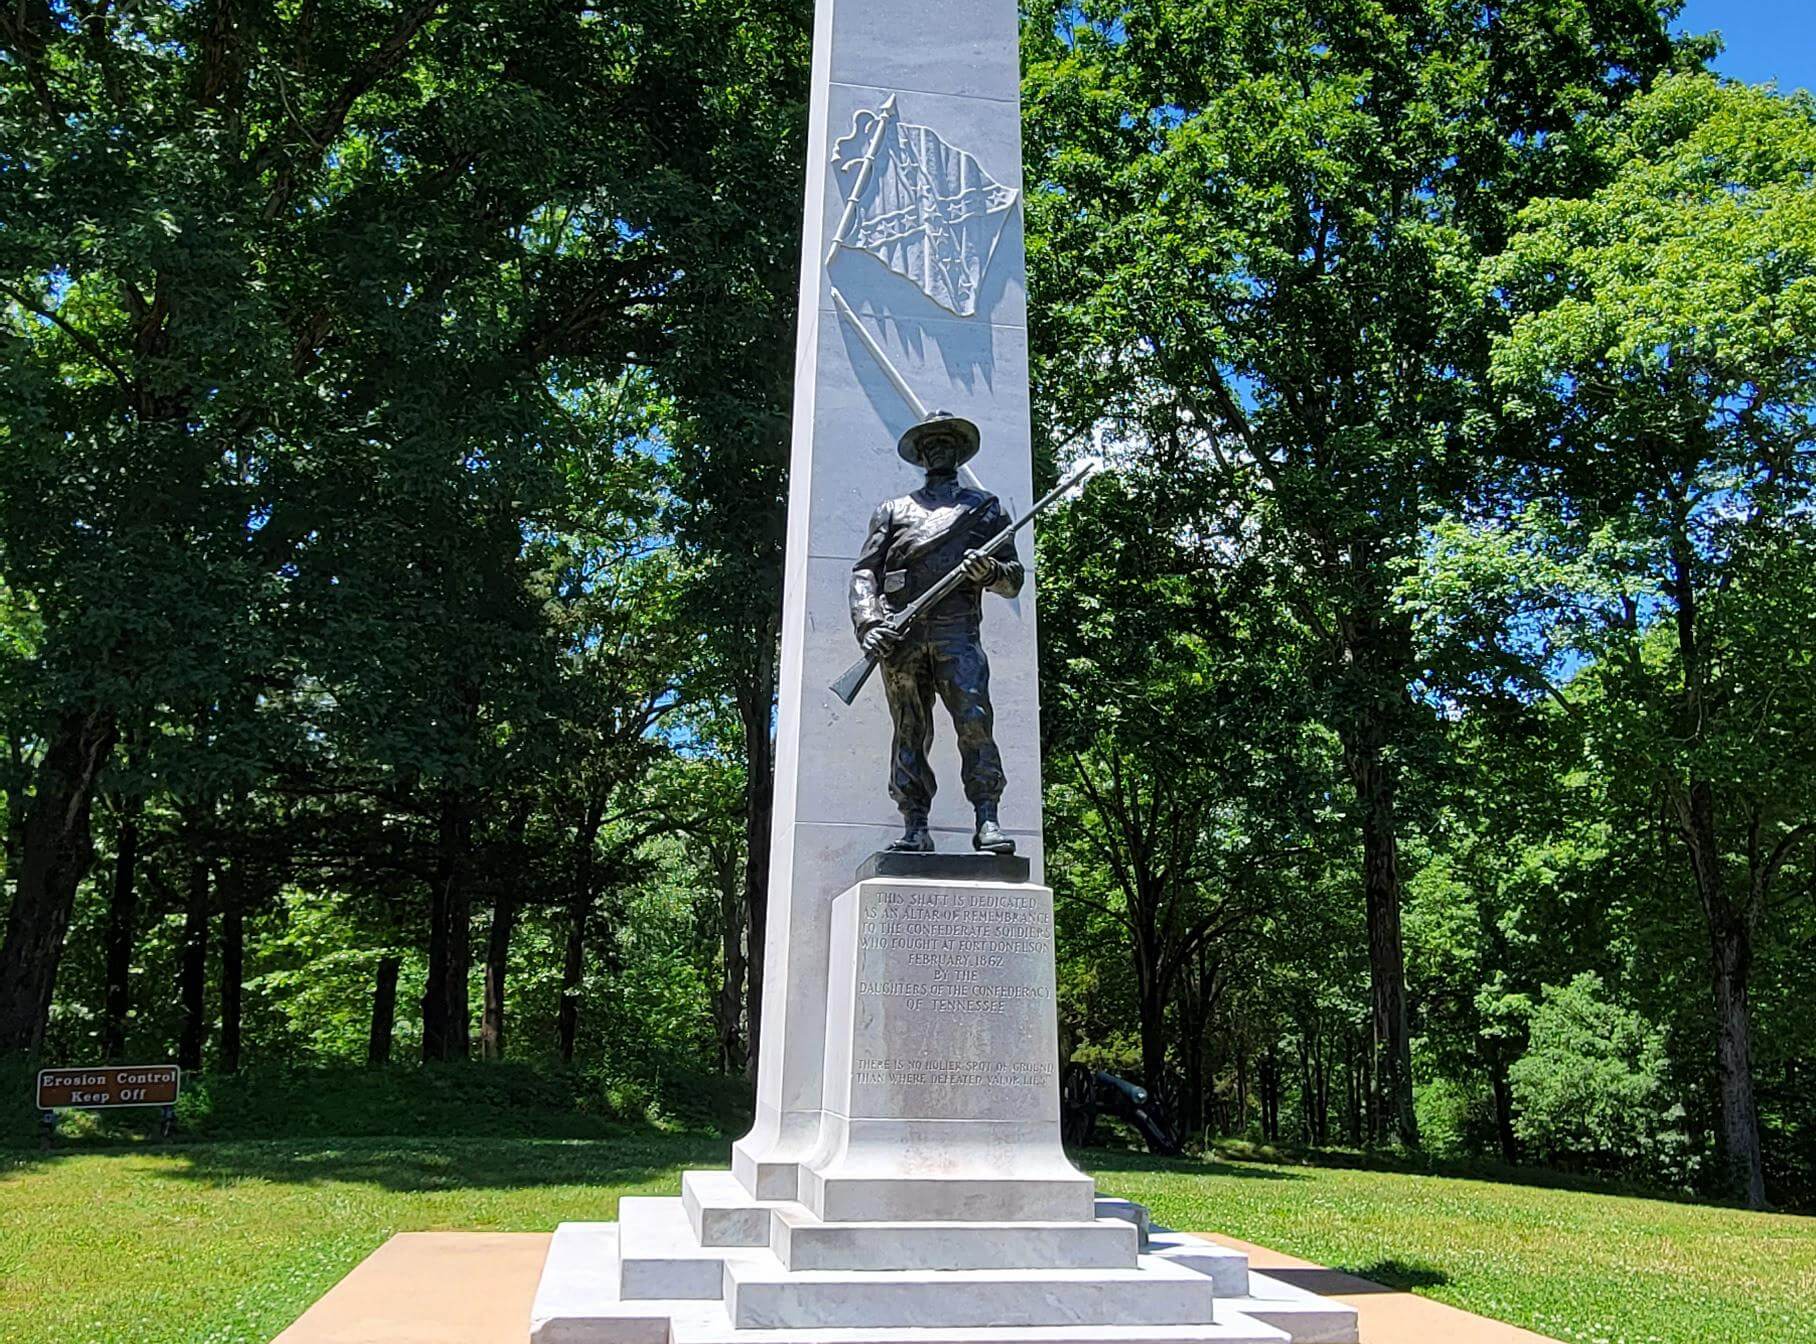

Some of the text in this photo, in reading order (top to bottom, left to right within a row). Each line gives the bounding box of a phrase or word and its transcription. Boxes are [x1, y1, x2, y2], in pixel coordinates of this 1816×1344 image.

[877, 891, 1036, 909] THIS SHAFT IS DEDICATED
[864, 905, 1049, 924] AS AN ALTAR OF REMEMBRANCE
[863, 921, 1050, 940] TO THE CONFEDERATE SOLDIERS
[860, 936, 1049, 954] WHO FOUGHT AT FORT DONELSON
[976, 954, 1004, 967] 1862
[934, 969, 978, 982] BY THE
[860, 981, 1050, 999] DAUGHTERS OF THE CONFEDERACY
[906, 998, 1006, 1013] OF TENNESSEE
[894, 1059, 904, 1070] IS
[908, 1059, 922, 1071] NO
[925, 1060, 961, 1072] HOLIER
[966, 1061, 991, 1072] SPOT
[996, 1062, 1007, 1073] OF
[1013, 1062, 1054, 1073] GROUND
[42, 1071, 176, 1087] Erosion Control
[856, 1072, 884, 1084] THAN
[889, 1072, 926, 1084] WHERE
[931, 1074, 982, 1085] DEFEATED
[71, 1088, 146, 1104] Keep Off
